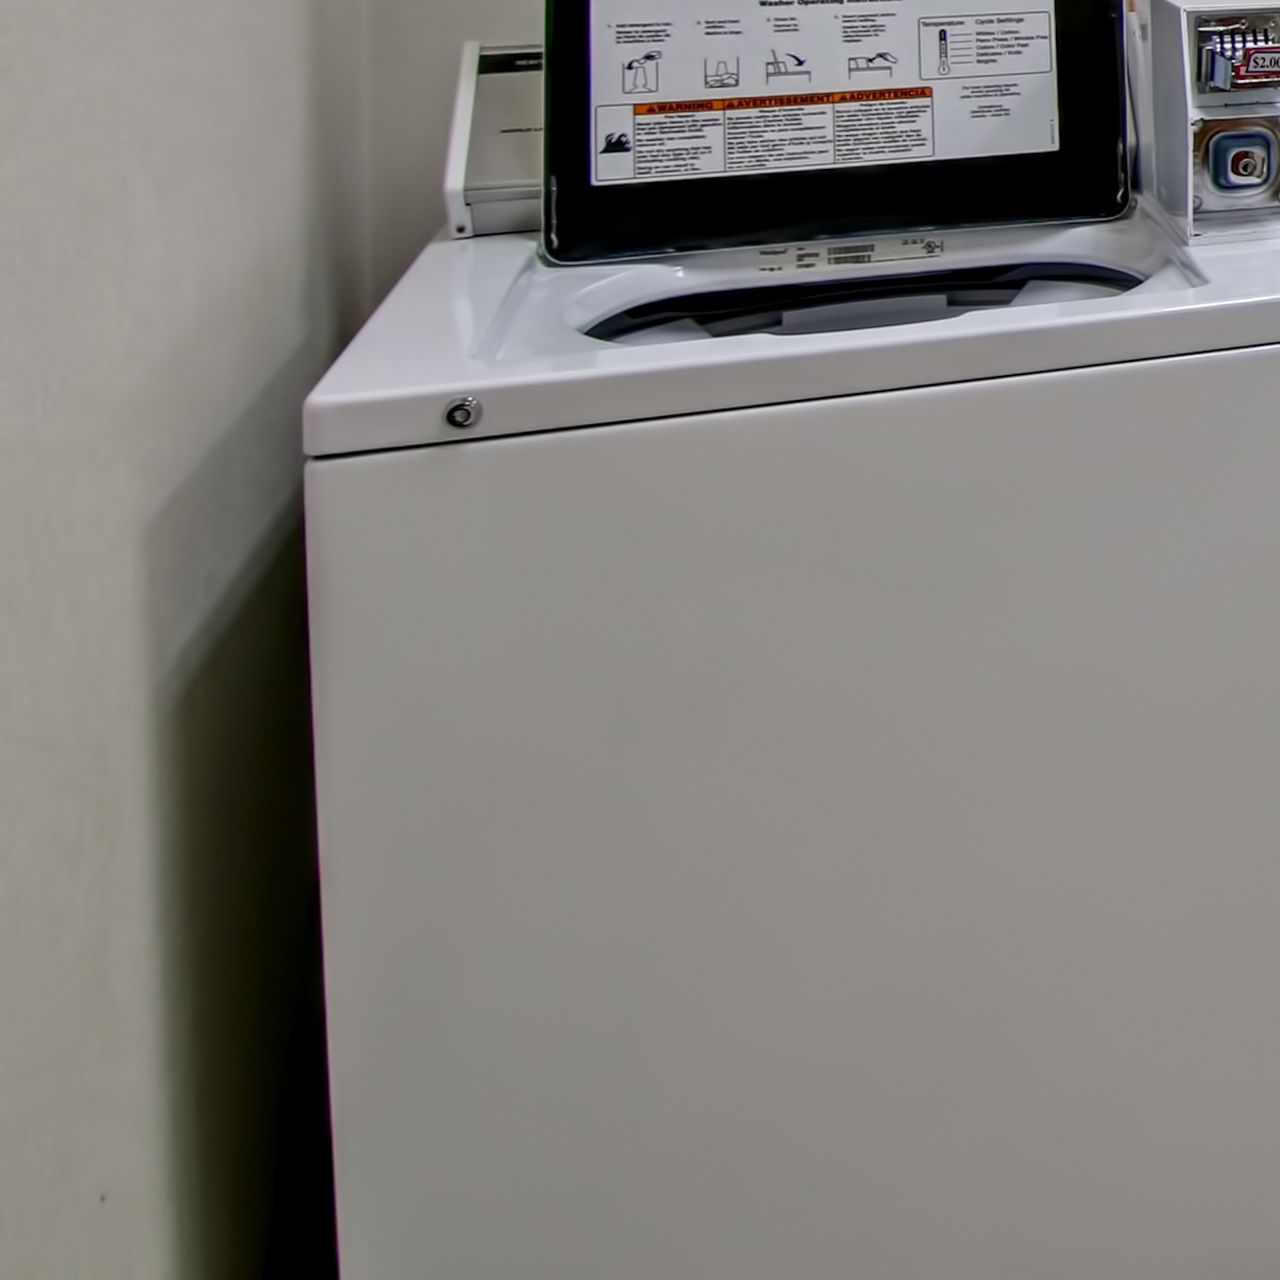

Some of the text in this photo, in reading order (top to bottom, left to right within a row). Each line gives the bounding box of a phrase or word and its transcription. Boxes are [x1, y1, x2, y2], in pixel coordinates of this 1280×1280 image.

[759, 0, 795, 7] Washer
[656, 88, 926, 112] WARNING AVERTISSEMENT ADVERTENCIA
